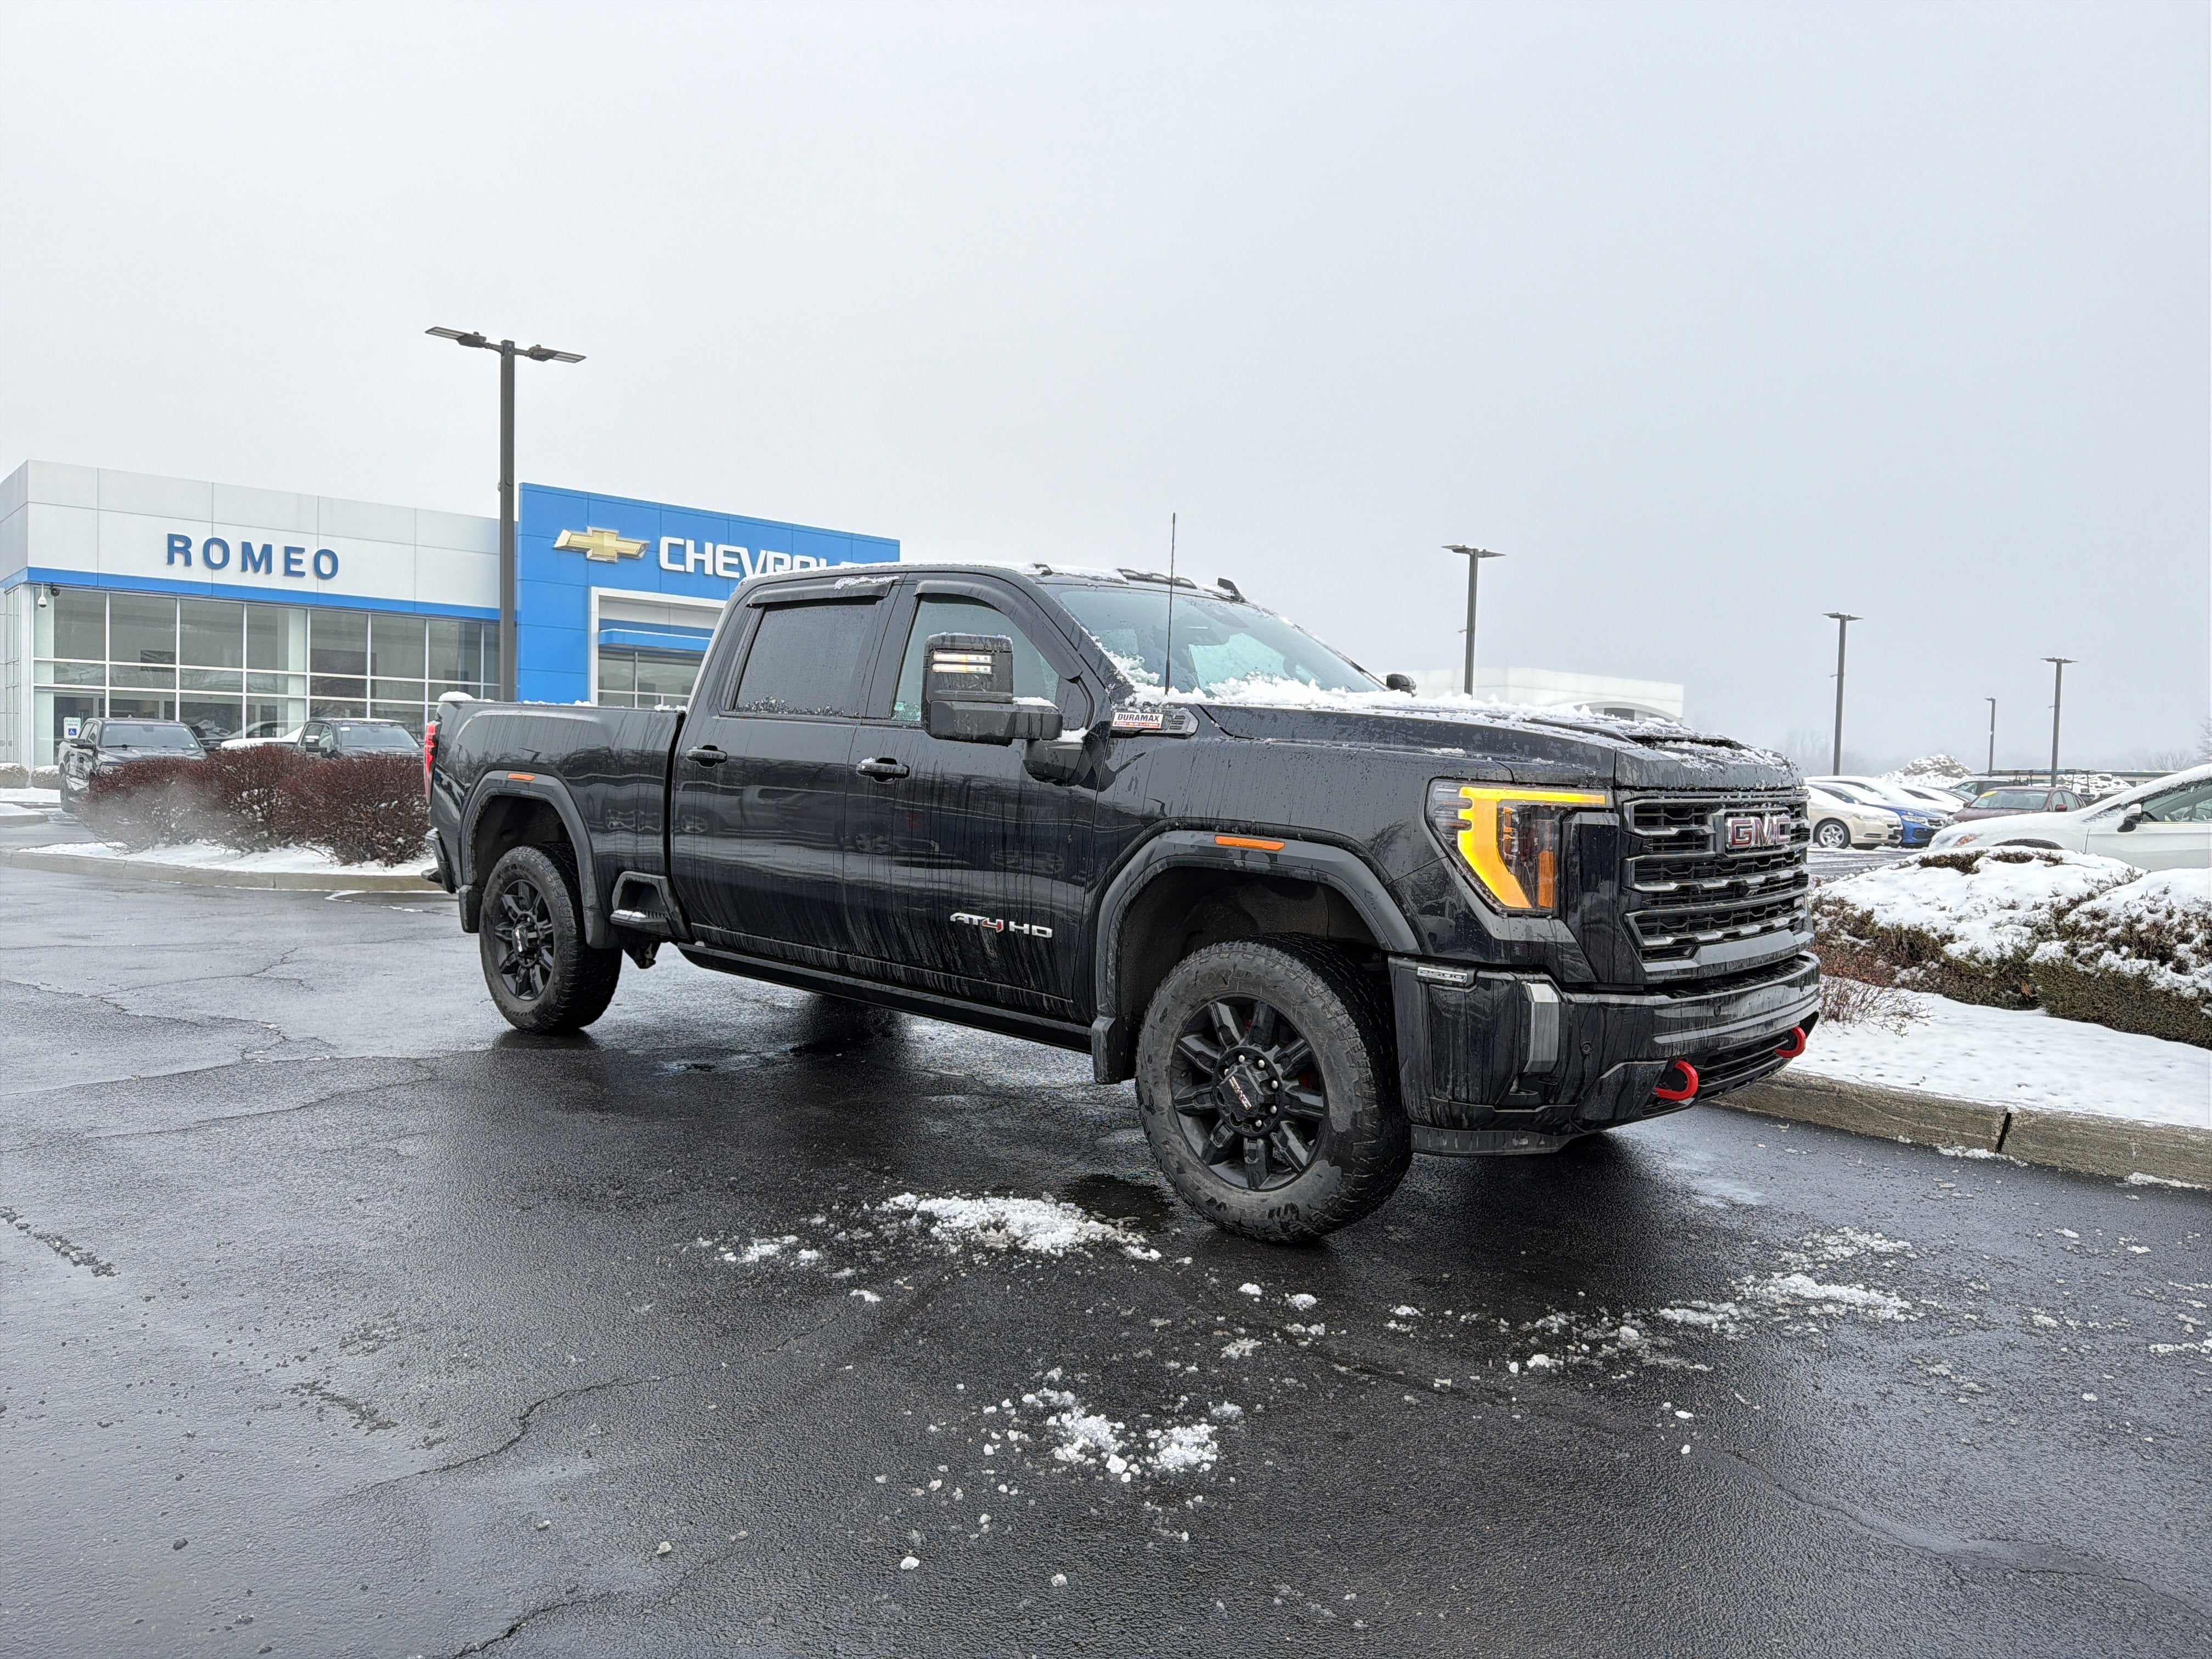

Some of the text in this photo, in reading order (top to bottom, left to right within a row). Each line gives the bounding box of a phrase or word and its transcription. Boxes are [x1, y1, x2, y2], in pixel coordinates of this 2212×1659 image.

[167, 533, 338, 580] ROMEO
[1117, 714, 1160, 723] DURAMAX
[1726, 816, 1791, 849] GMC
[950, 912, 1053, 938] AT4 HD
[1229, 1076, 1252, 1110] GMC
